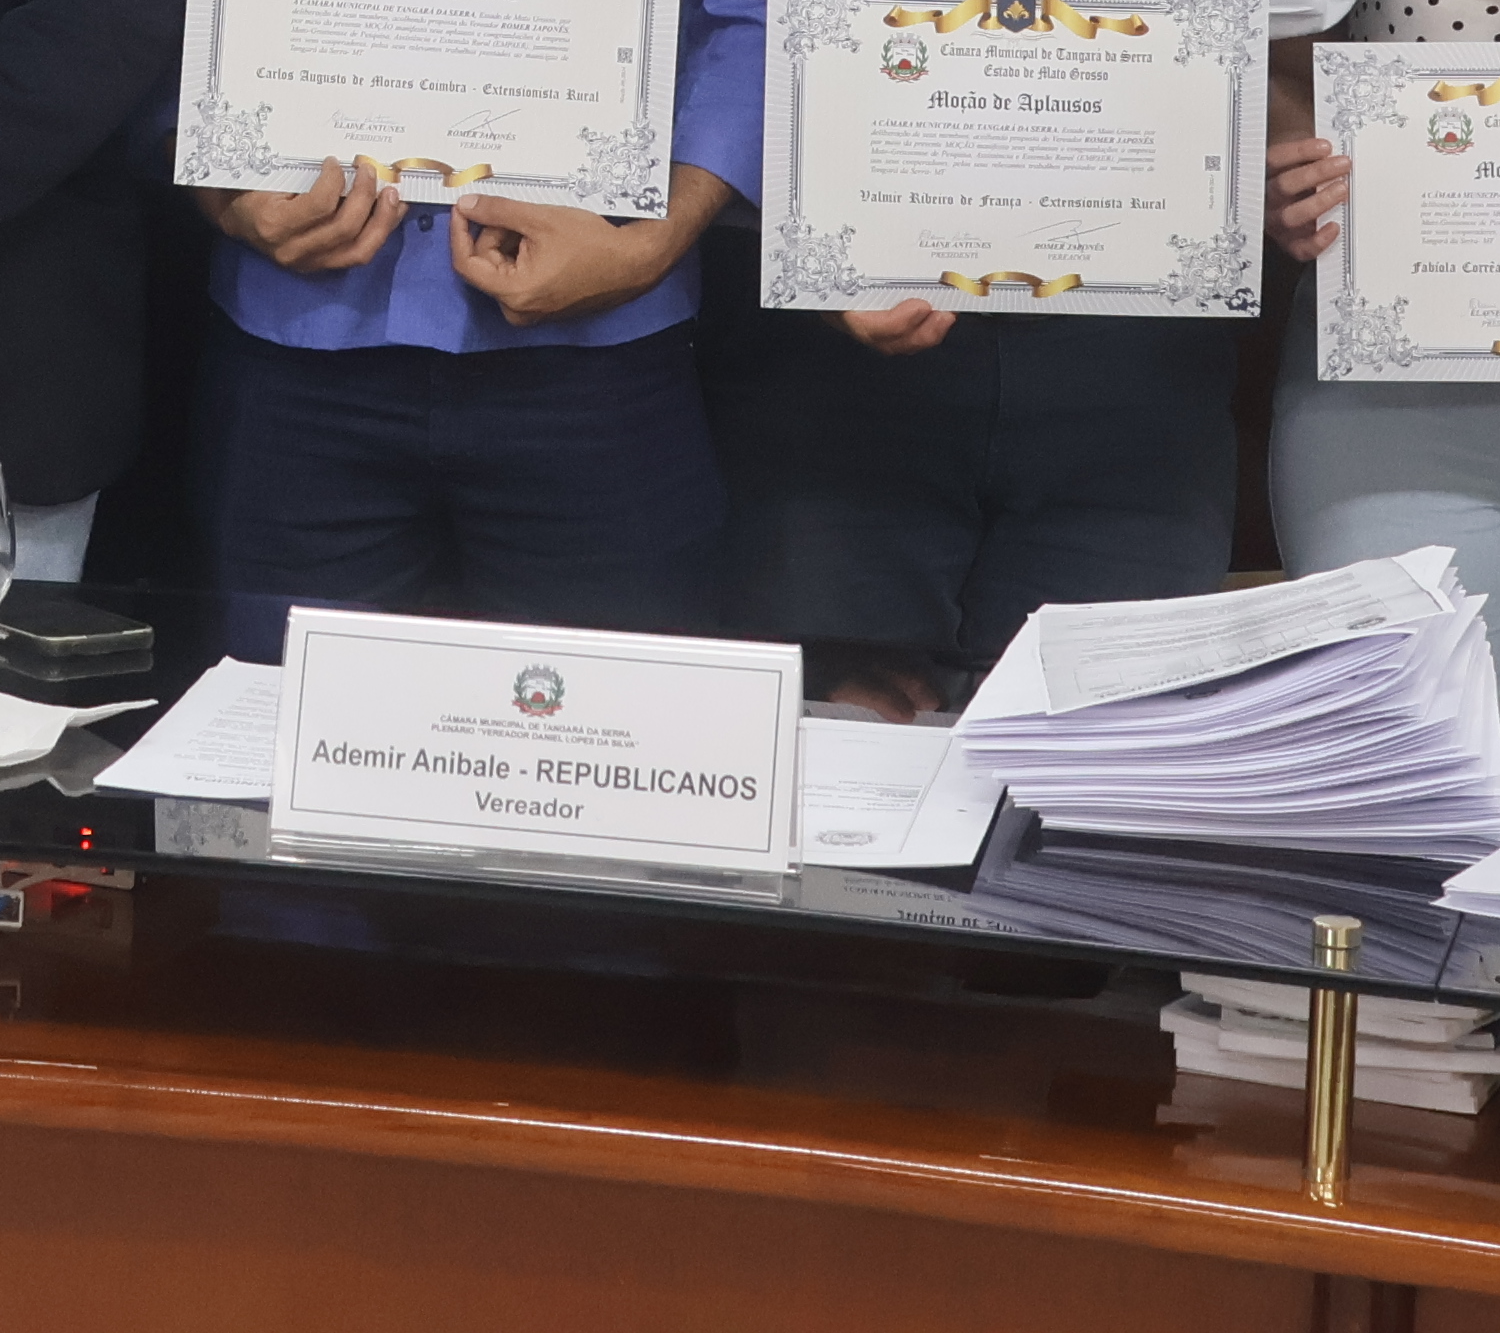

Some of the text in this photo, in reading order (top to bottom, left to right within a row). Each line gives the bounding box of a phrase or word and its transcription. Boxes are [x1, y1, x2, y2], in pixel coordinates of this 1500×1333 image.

[256, 67, 293, 81] Carlos
[300, 70, 346, 85] Augusto
[353, 74, 364, 85] de
[370, 75, 413, 90] Moraes
[420, 79, 466, 93] Coimbra
[483, 83, 559, 100] Extensionista
[566, 88, 598, 103] Rural
[928, 90, 1102, 114] Moção de Aplausos
[860, 189, 902, 203] Valmir
[910, 191, 953, 205] Ribeiro
[961, 194, 972, 205] de
[979, 195, 1021, 209] França
[1039, 196, 1122, 209] Extensionista
[1130, 198, 1165, 210] Rural
[312, 739, 405, 769] Ademir
[412, 748, 509, 779] Anibale
[537, 759, 756, 801] REPUBLICANOS
[476, 790, 584, 820] Vereador
